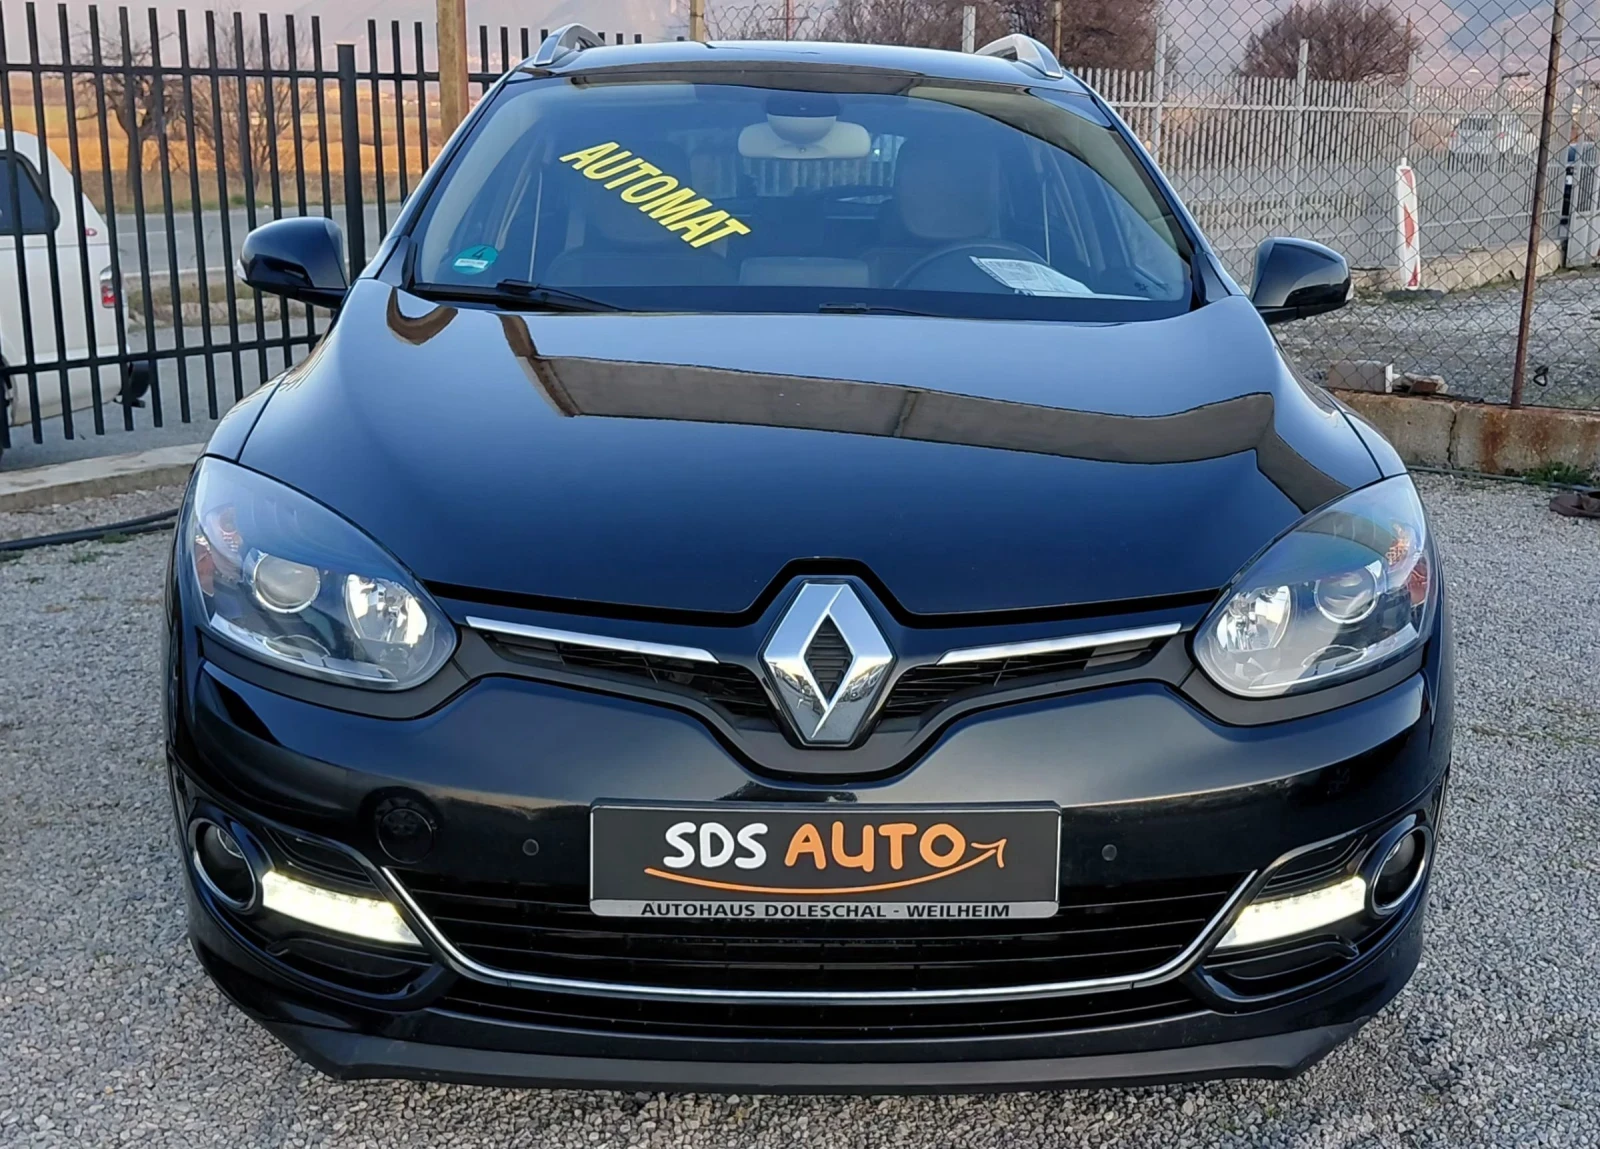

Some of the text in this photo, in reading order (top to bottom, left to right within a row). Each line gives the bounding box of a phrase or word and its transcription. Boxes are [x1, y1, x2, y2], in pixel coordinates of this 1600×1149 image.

[559, 141, 751, 248] AUTOMAT
[471, 246, 488, 260] 4
[662, 821, 966, 872] SDS AUTO
[641, 902, 756, 918] AUTOHAUS
[764, 903, 887, 918] DOLESCHAL
[906, 904, 1010, 918] WEILHEIM
